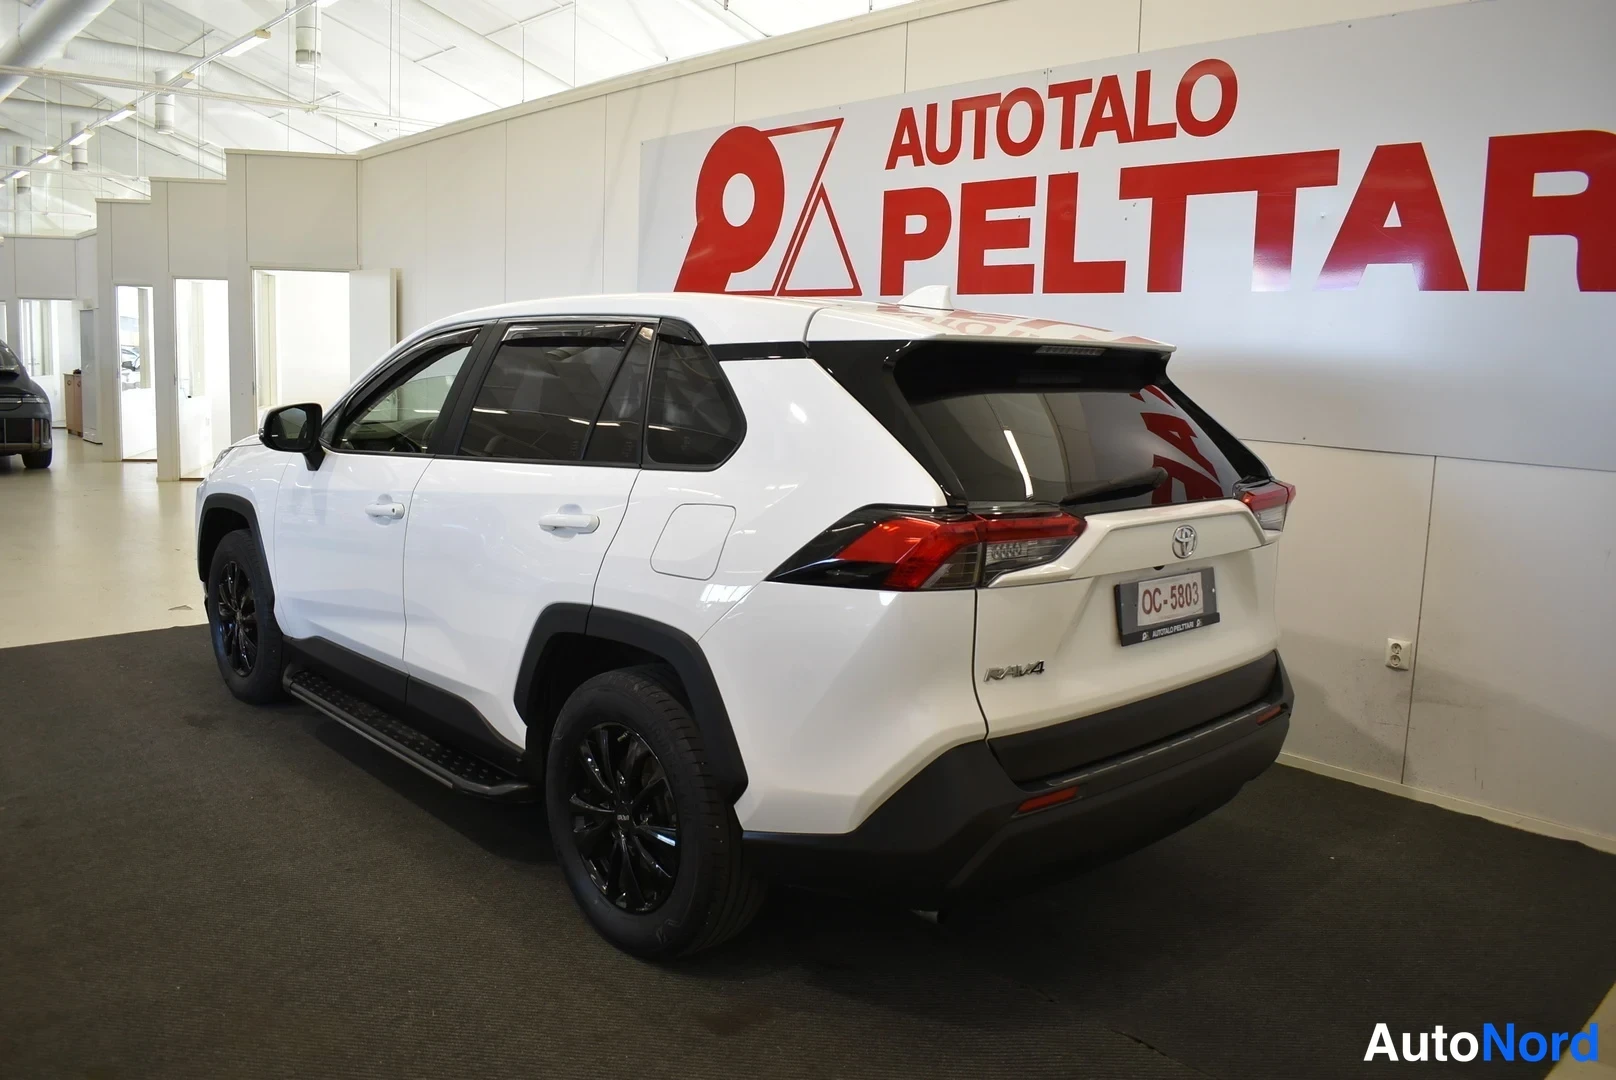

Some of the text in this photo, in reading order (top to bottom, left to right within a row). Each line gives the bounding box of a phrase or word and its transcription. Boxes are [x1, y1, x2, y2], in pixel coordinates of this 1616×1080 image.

[885, 58, 1238, 171] AUTOTALO
[1141, 581, 1200, 615] OC-5803
[1152, 621, 1194, 638] AUTOTALO PELTTARI
[983, 660, 1046, 682] RAV4
